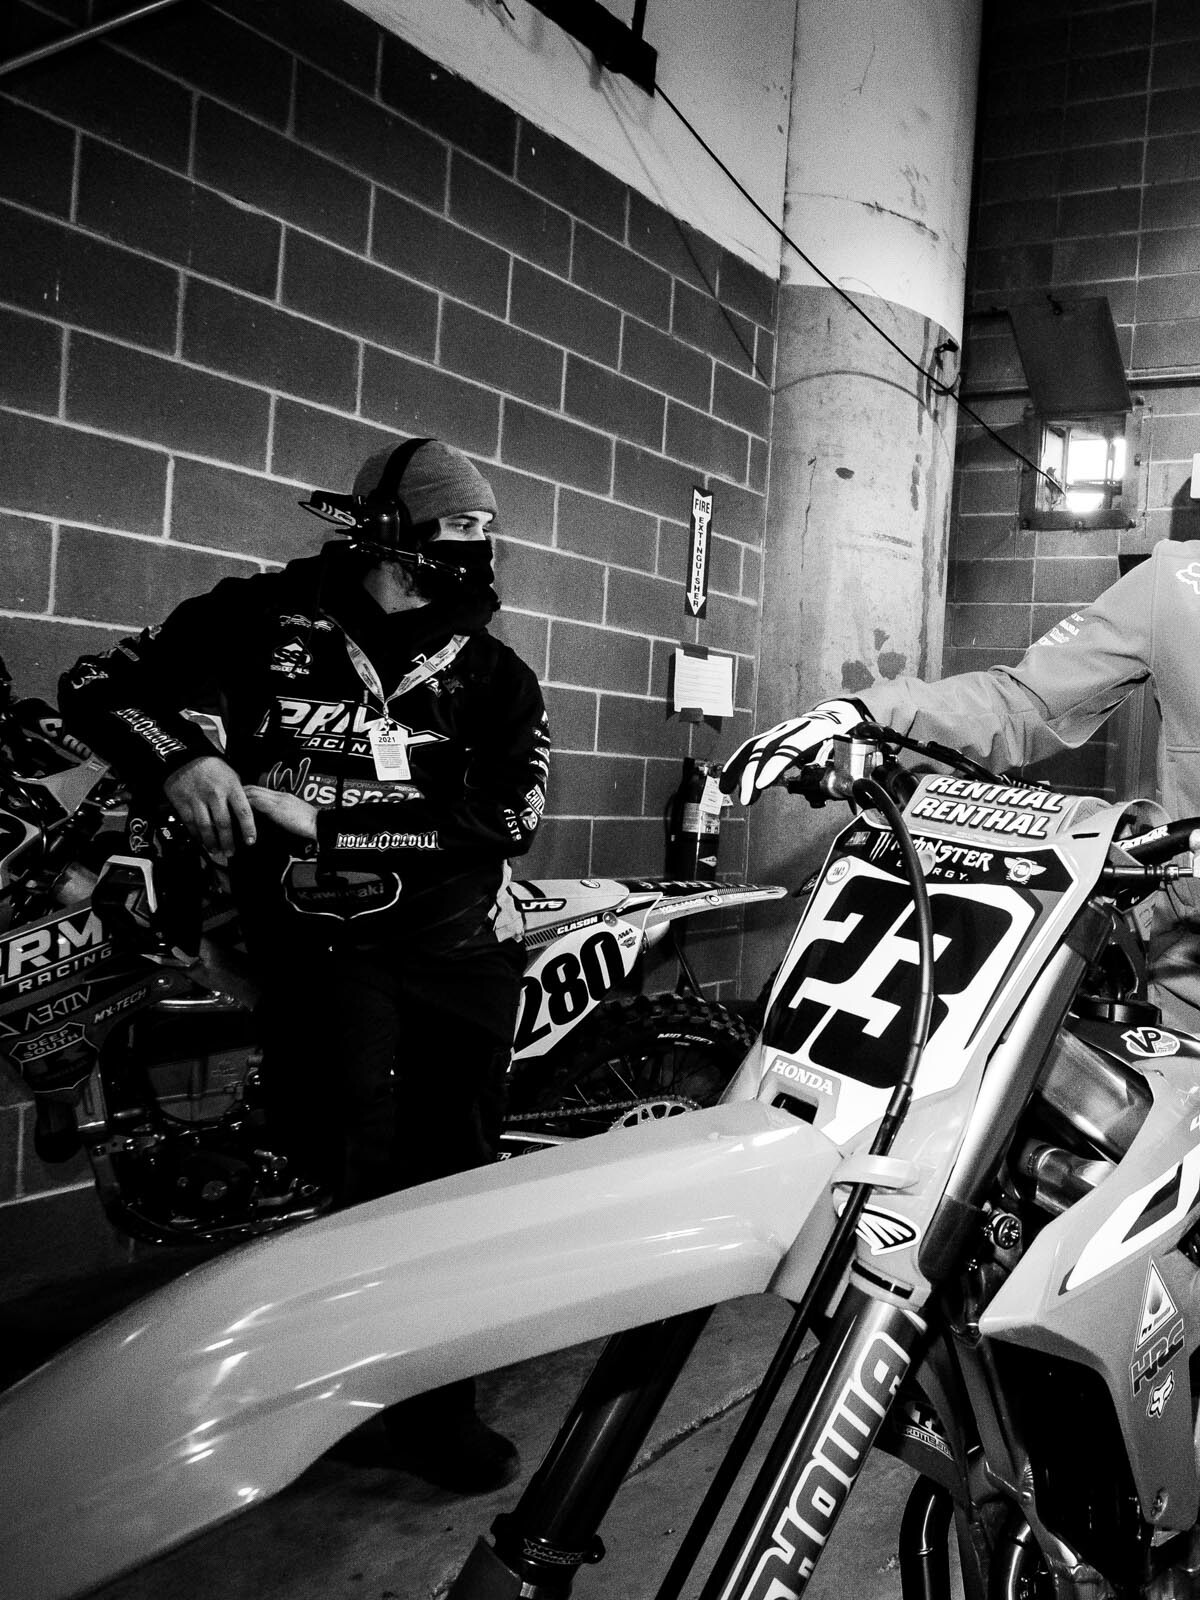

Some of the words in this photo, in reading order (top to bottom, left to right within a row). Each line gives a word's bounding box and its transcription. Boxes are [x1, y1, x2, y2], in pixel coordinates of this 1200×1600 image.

[694, 498, 711, 514] FIRE
[692, 516, 705, 608] EXTINGUISHER
[925, 776, 1065, 812] RENTHAL
[910, 796, 1050, 838] RENTHAL
[520, 900, 564, 911] UTS
[556, 915, 599, 935] CLASON
[0, 911, 103, 984] RM
[18, 946, 113, 993] RACING
[761, 875, 1013, 1089] 23
[94, 988, 147, 1024] MX-TECH
[512, 931, 626, 1056] 280
[23, 1033, 79, 1060] SOUTH
[26, 1029, 70, 1051] DEEP
[1126, 1028, 1162, 1054] VP
[771, 1058, 835, 1096] HONDA
[1130, 1318, 1185, 1398] HRC
